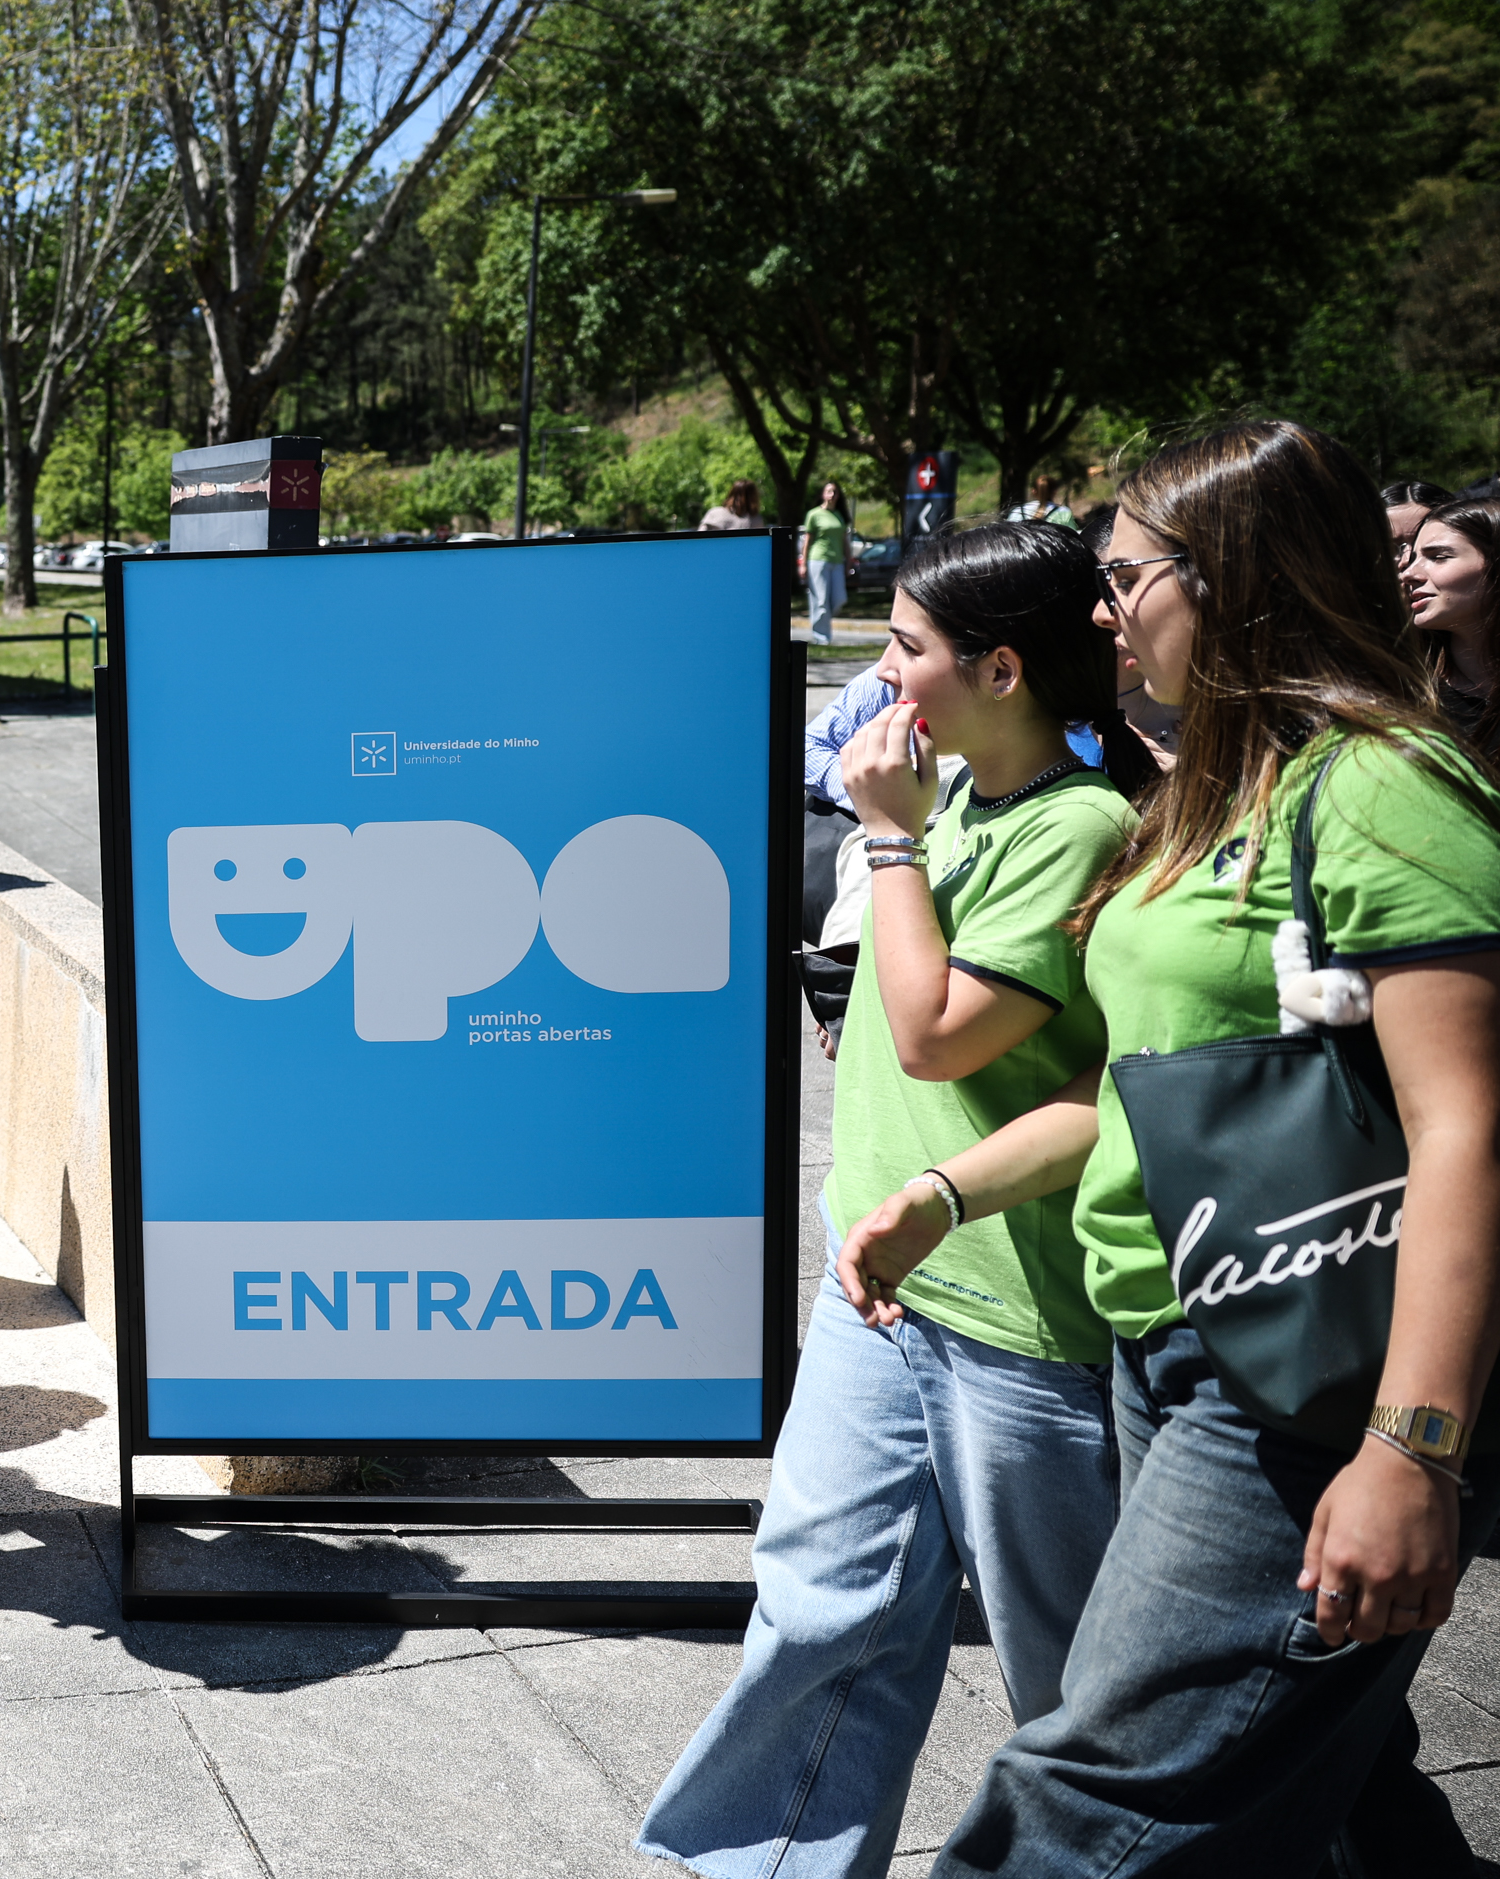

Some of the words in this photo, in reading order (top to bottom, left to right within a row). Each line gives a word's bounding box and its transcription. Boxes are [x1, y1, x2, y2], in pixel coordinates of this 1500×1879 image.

[403, 739, 481, 751] Universidade
[485, 738, 501, 749] do
[503, 737, 540, 748] Minho
[403, 754, 462, 767] uminho.pt
[166, 814, 731, 1042] upa
[468, 1010, 542, 1026] uminho
[468, 1027, 532, 1046] portas
[537, 1026, 613, 1042] abertas
[233, 1268, 679, 1332] ENTRADA
